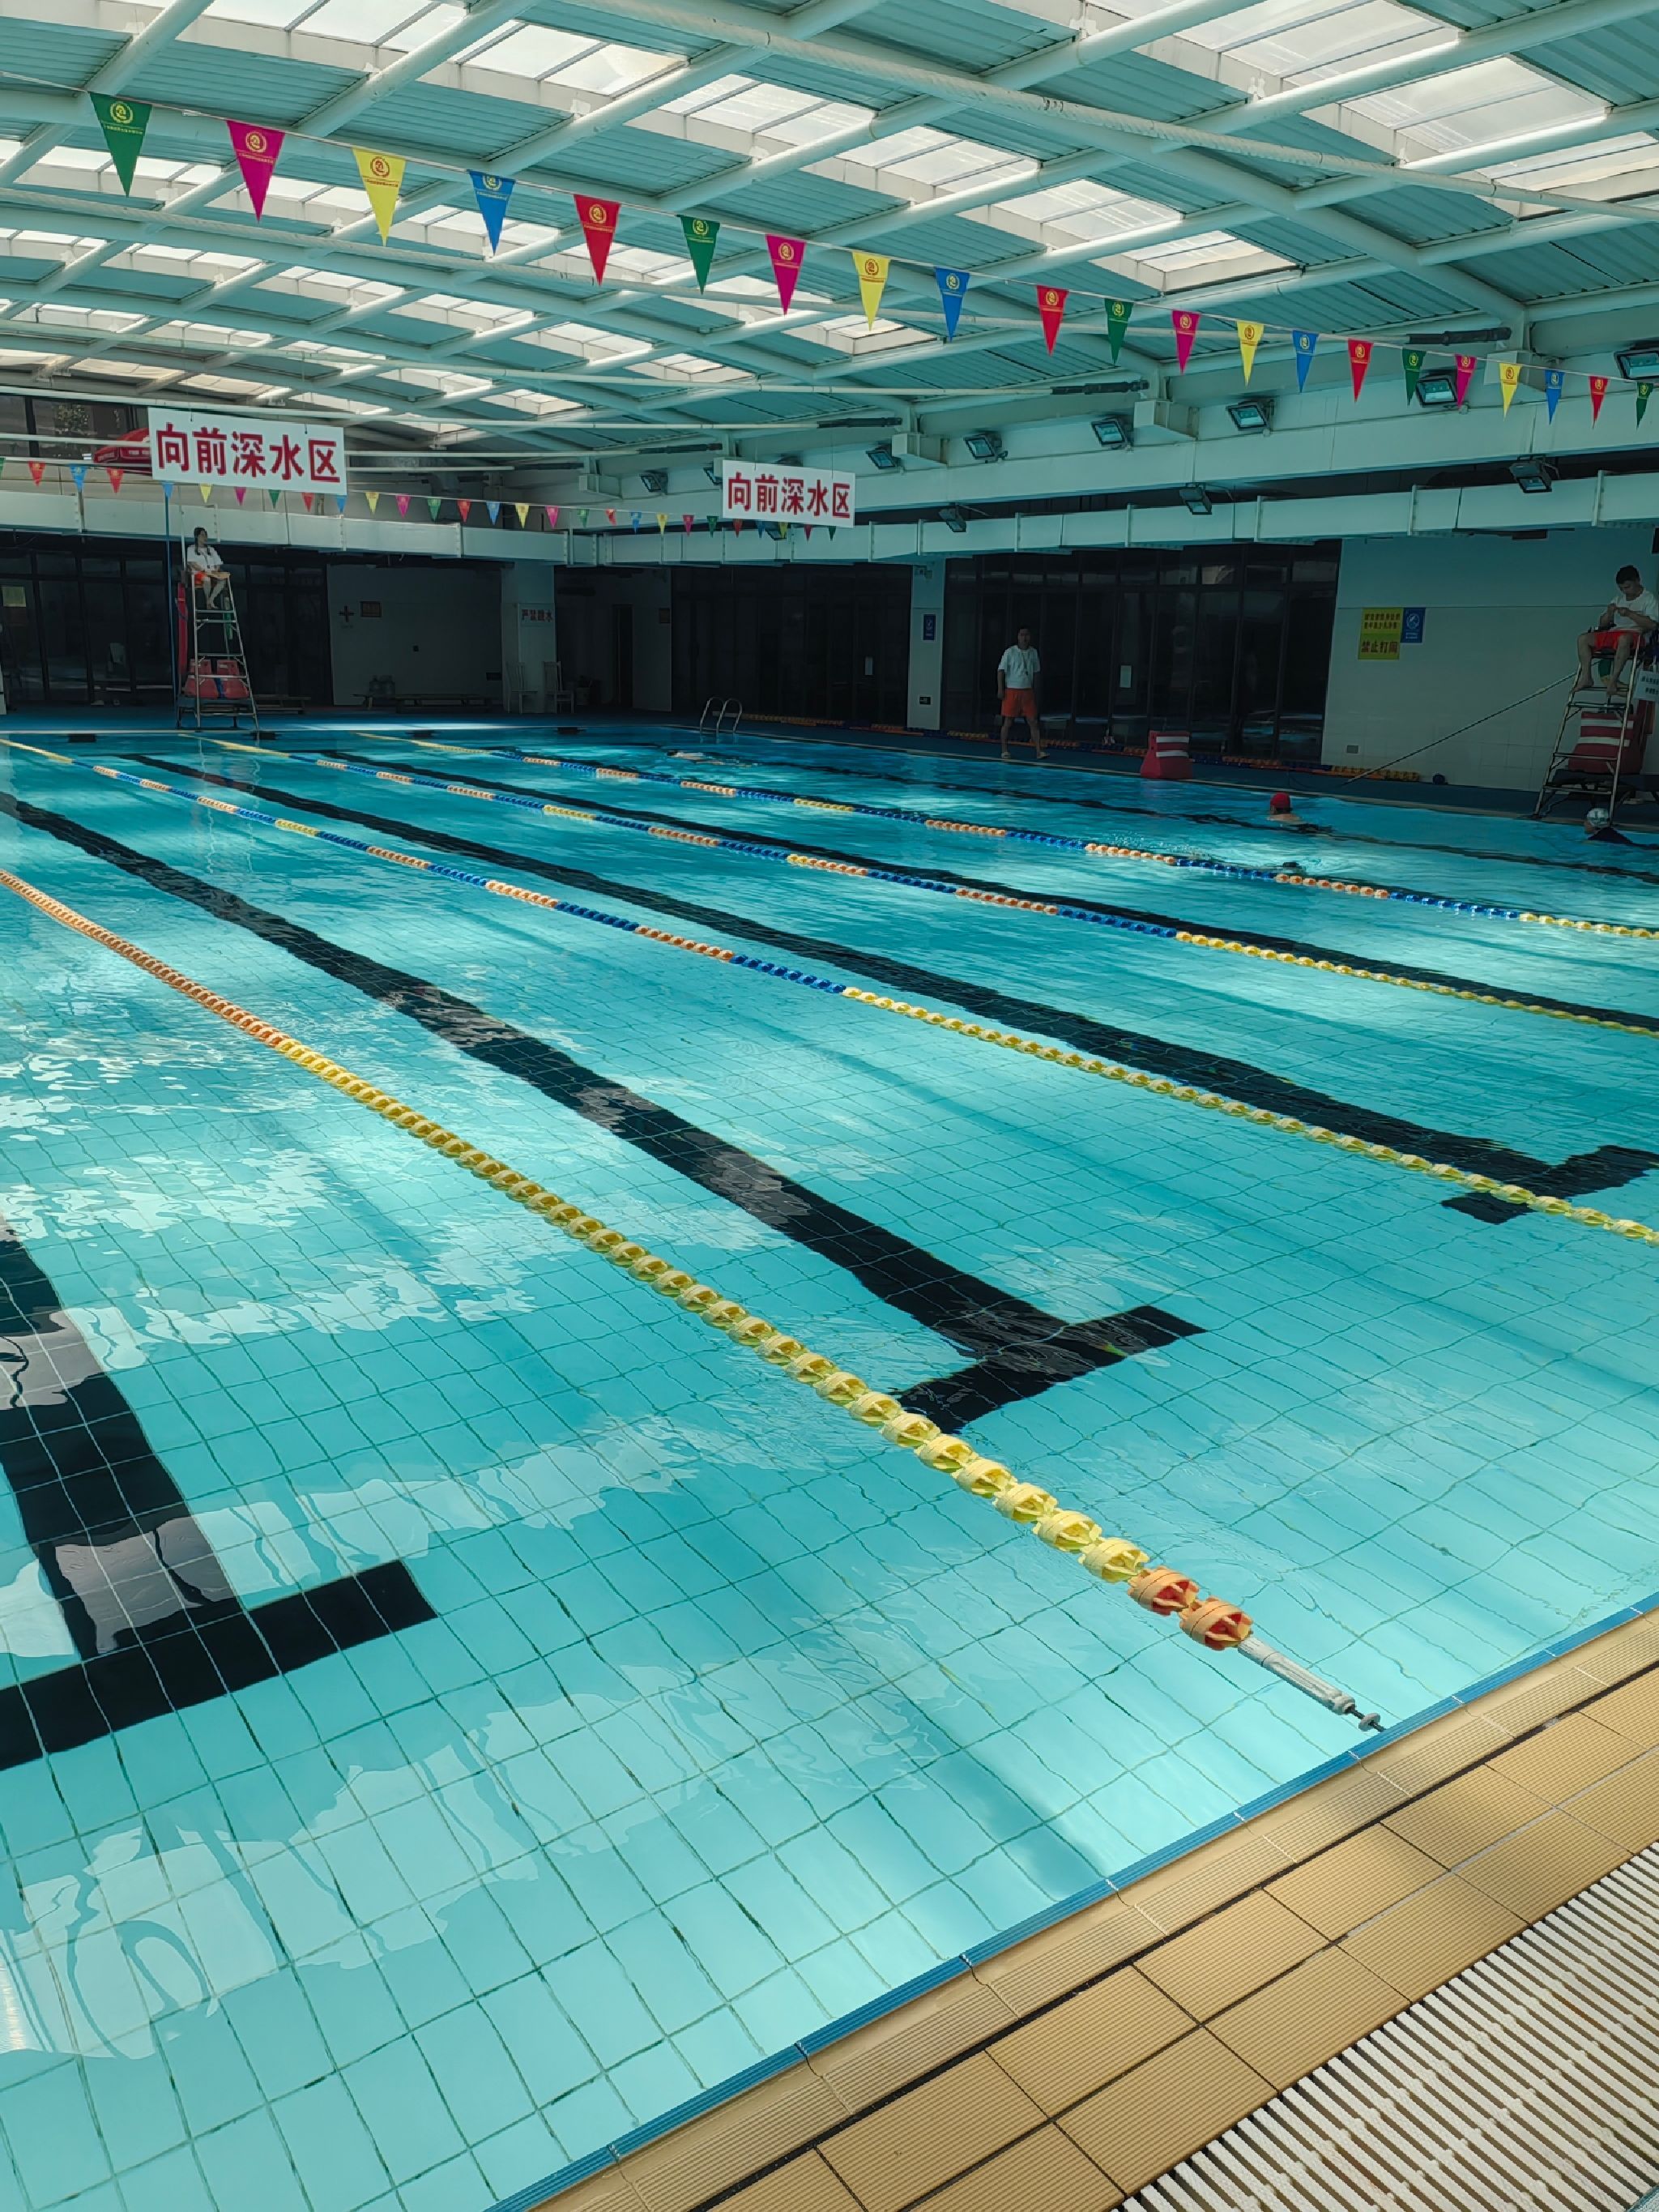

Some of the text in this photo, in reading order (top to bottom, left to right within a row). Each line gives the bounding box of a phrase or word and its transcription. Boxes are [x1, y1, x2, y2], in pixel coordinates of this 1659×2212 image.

[156, 422, 340, 483] 向前深水区
[727, 472, 851, 519] 向前深水区
